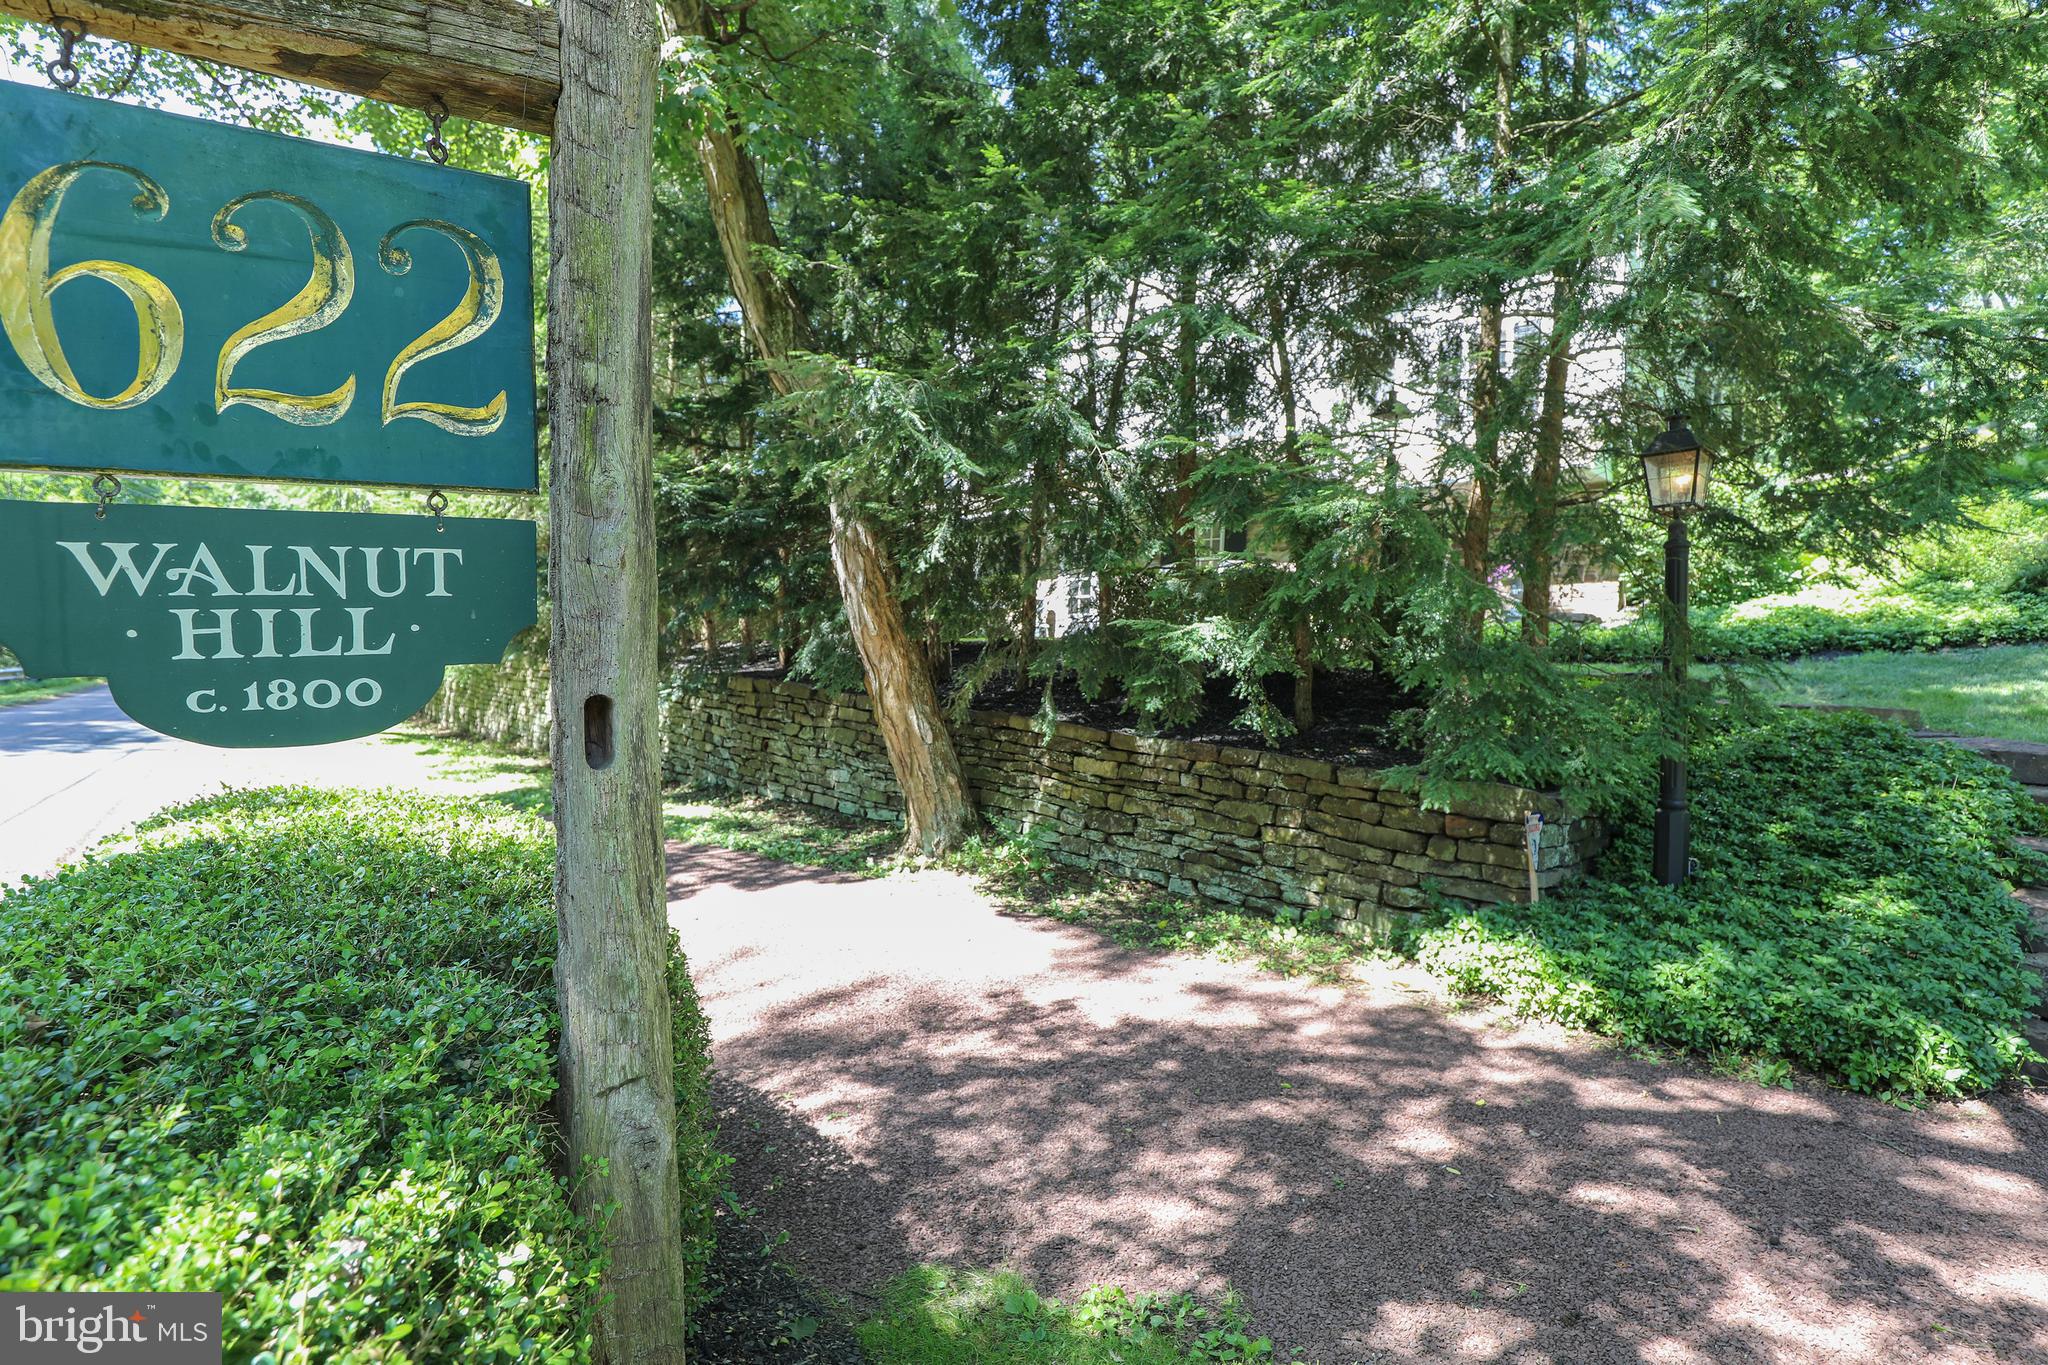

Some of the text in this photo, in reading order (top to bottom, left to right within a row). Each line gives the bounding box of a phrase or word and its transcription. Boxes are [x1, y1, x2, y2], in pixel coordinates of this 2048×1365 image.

[0, 160, 507, 437] 622
[55, 541, 463, 600] WALNUT
[168, 607, 396, 660] HILL
[242, 677, 383, 712] 1800
